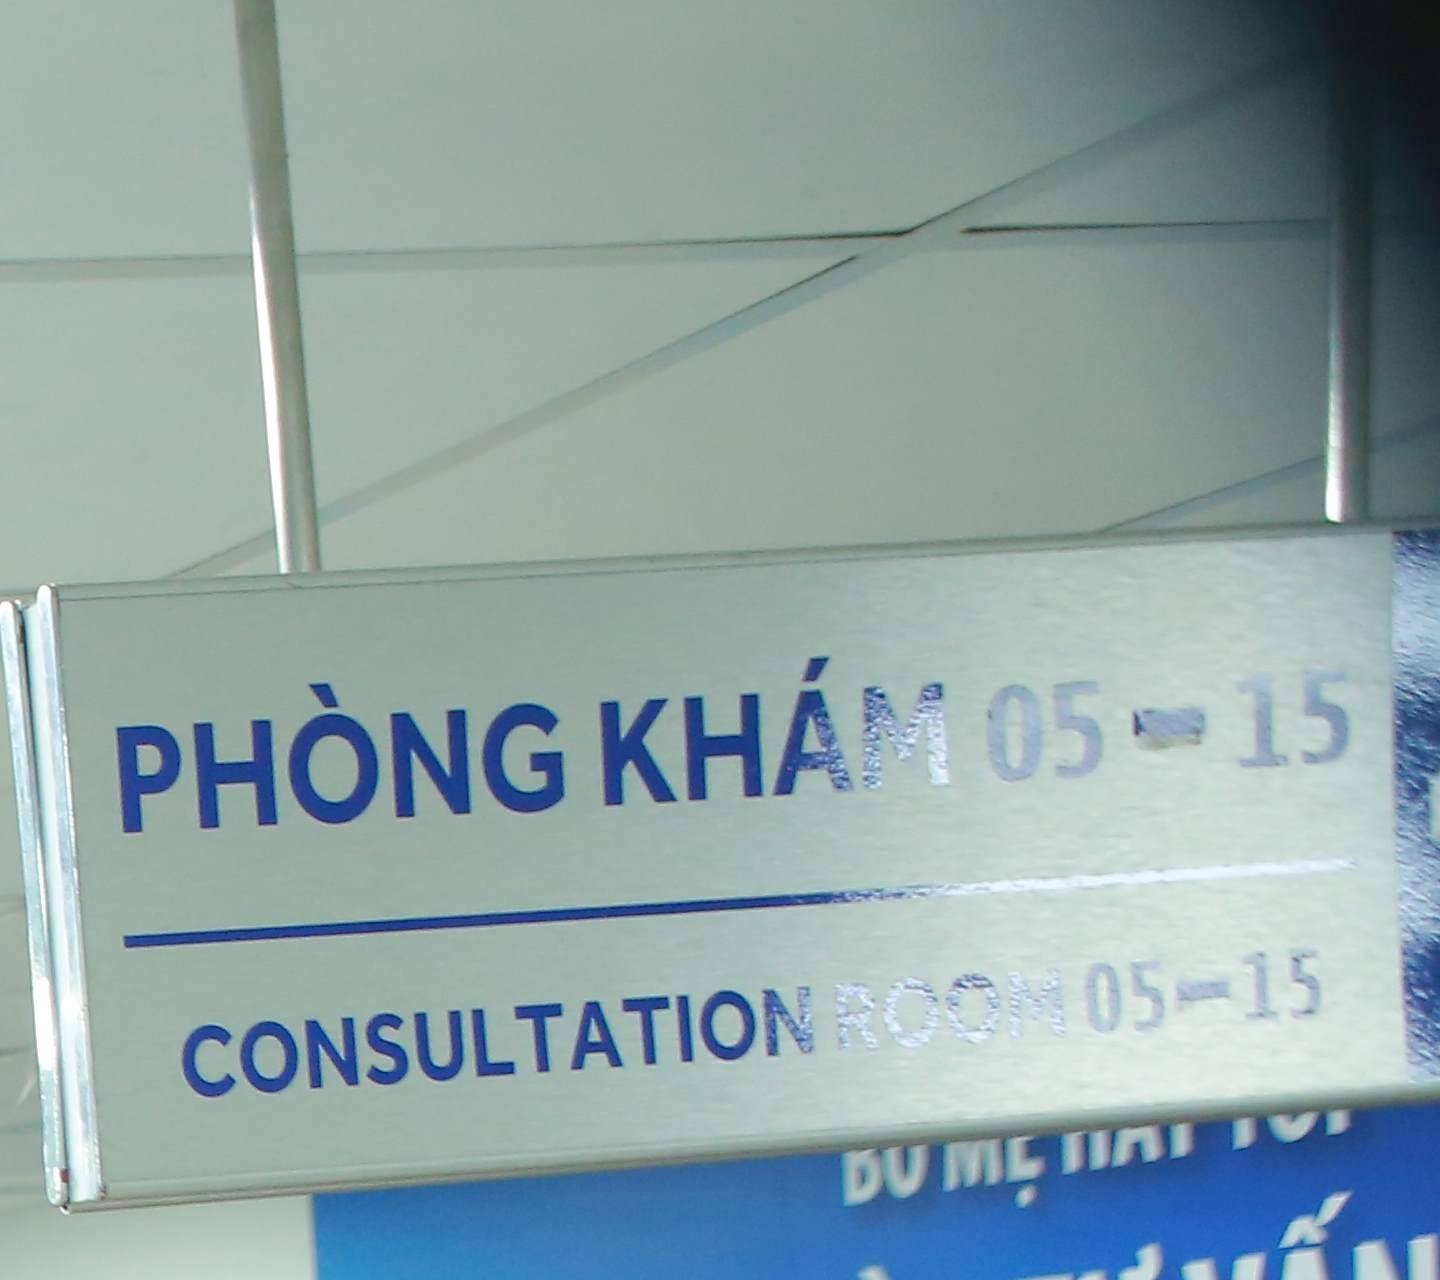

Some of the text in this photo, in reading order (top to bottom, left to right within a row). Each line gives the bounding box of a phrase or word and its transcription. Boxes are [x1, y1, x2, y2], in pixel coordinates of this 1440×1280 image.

[116, 682, 569, 834] PHÒNG
[600, 656, 952, 806] KHÁM
[986, 681, 1106, 784] 05
[1237, 668, 1353, 772] 15
[180, 985, 817, 1098] CONSULTATION
[834, 968, 1066, 1055] ROOM
